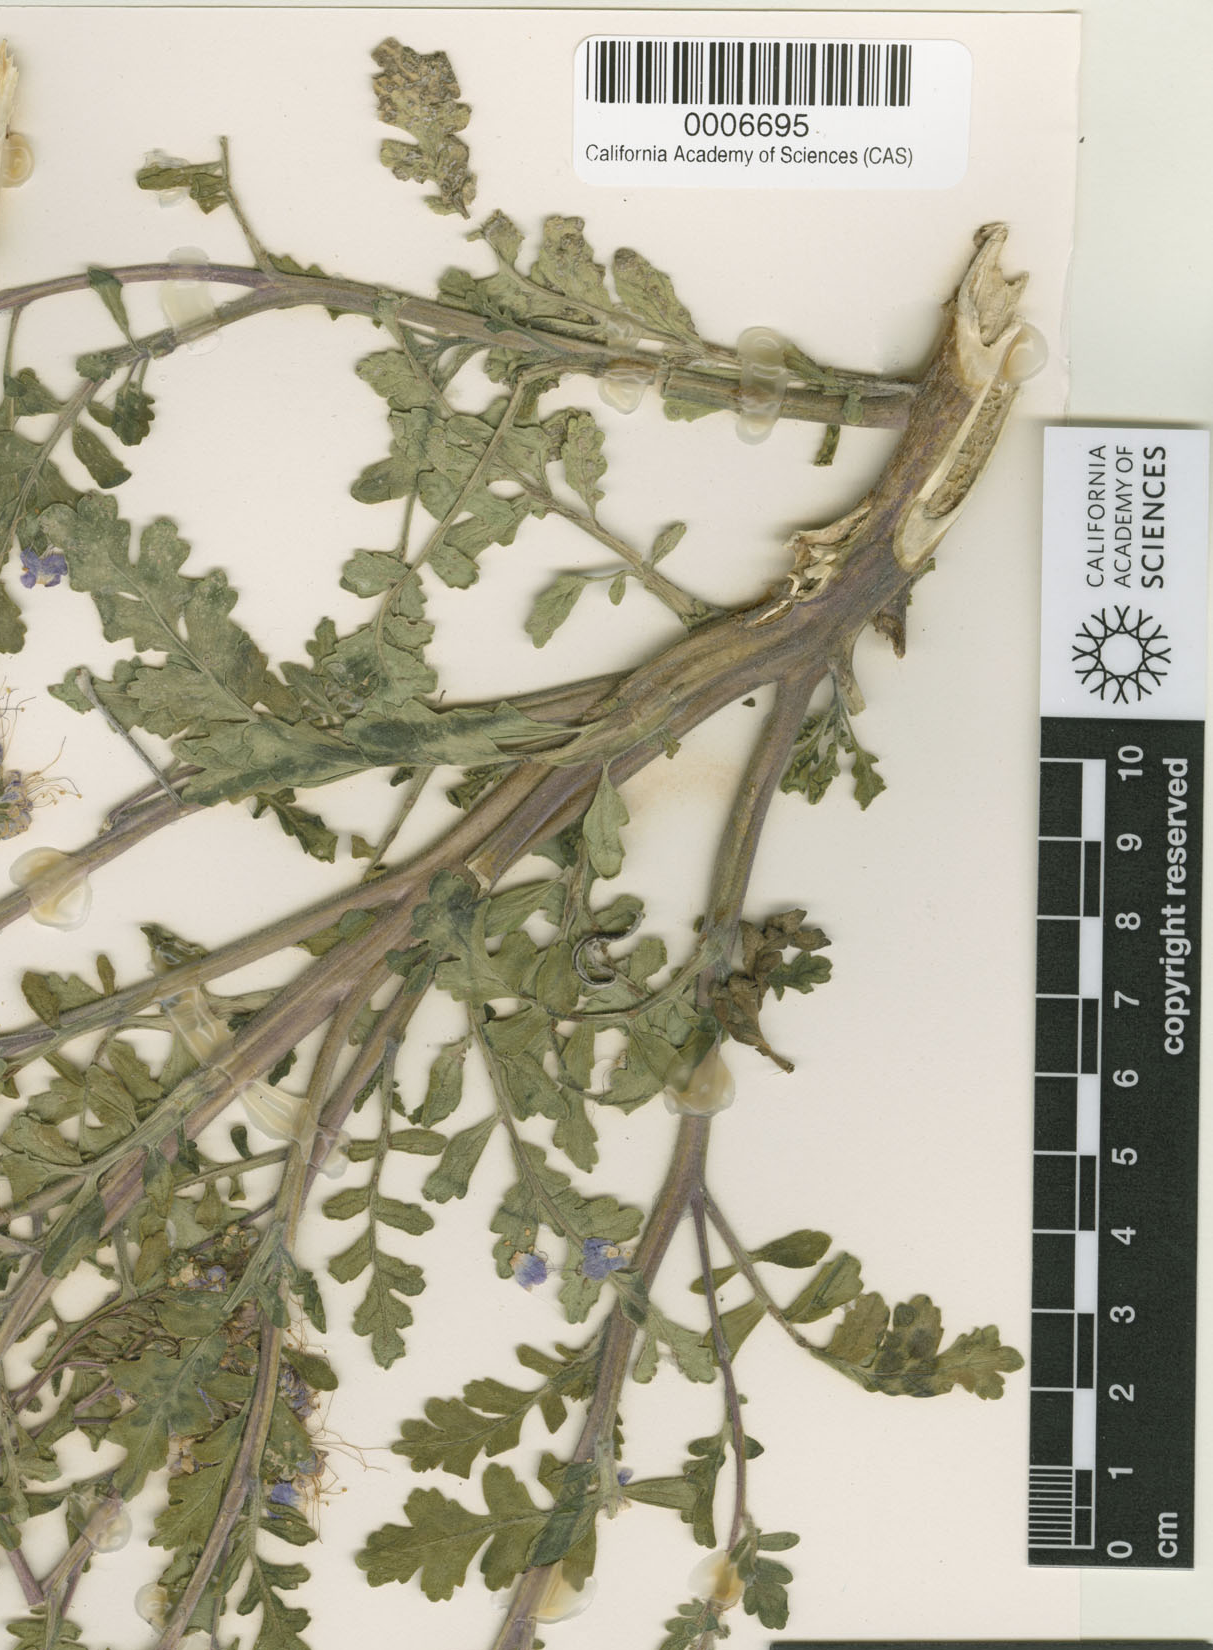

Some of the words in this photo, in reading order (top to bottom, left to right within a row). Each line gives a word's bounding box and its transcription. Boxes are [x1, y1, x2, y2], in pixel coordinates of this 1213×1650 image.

[684, 111, 809, 138] 0006695
[585, 144, 667, 162] California
[673, 145, 754, 166] Academy
[759, 146, 776, 163] of
[780, 146, 858, 165] Sciences
[863, 146, 914, 168] (CAS)
[1114, 445, 1134, 475] OF
[1086, 445, 1107, 588] CALIFORNIA
[1140, 446, 1166, 589] SCIENCES
[1113, 480, 1134, 589] ACADEMY
[1117, 745, 1144, 781] 10
[1160, 758, 1189, 897] reserved
[1116, 833, 1142, 852] 9
[1114, 912, 1141, 931] 8
[1158, 904, 1192, 1055] copyright
[1114, 990, 1140, 1009] 7
[1112, 1069, 1139, 1088] 6
[1111, 1147, 1138, 1166] 5
[1110, 1226, 1136, 1245] 4
[1109, 1305, 1136, 1324] 3
[1108, 1383, 1135, 1402] 2
[1107, 1467, 1133, 1479] 1
[1157, 1512, 1178, 1559] cm
[1107, 1540, 1133, 1559] 0
